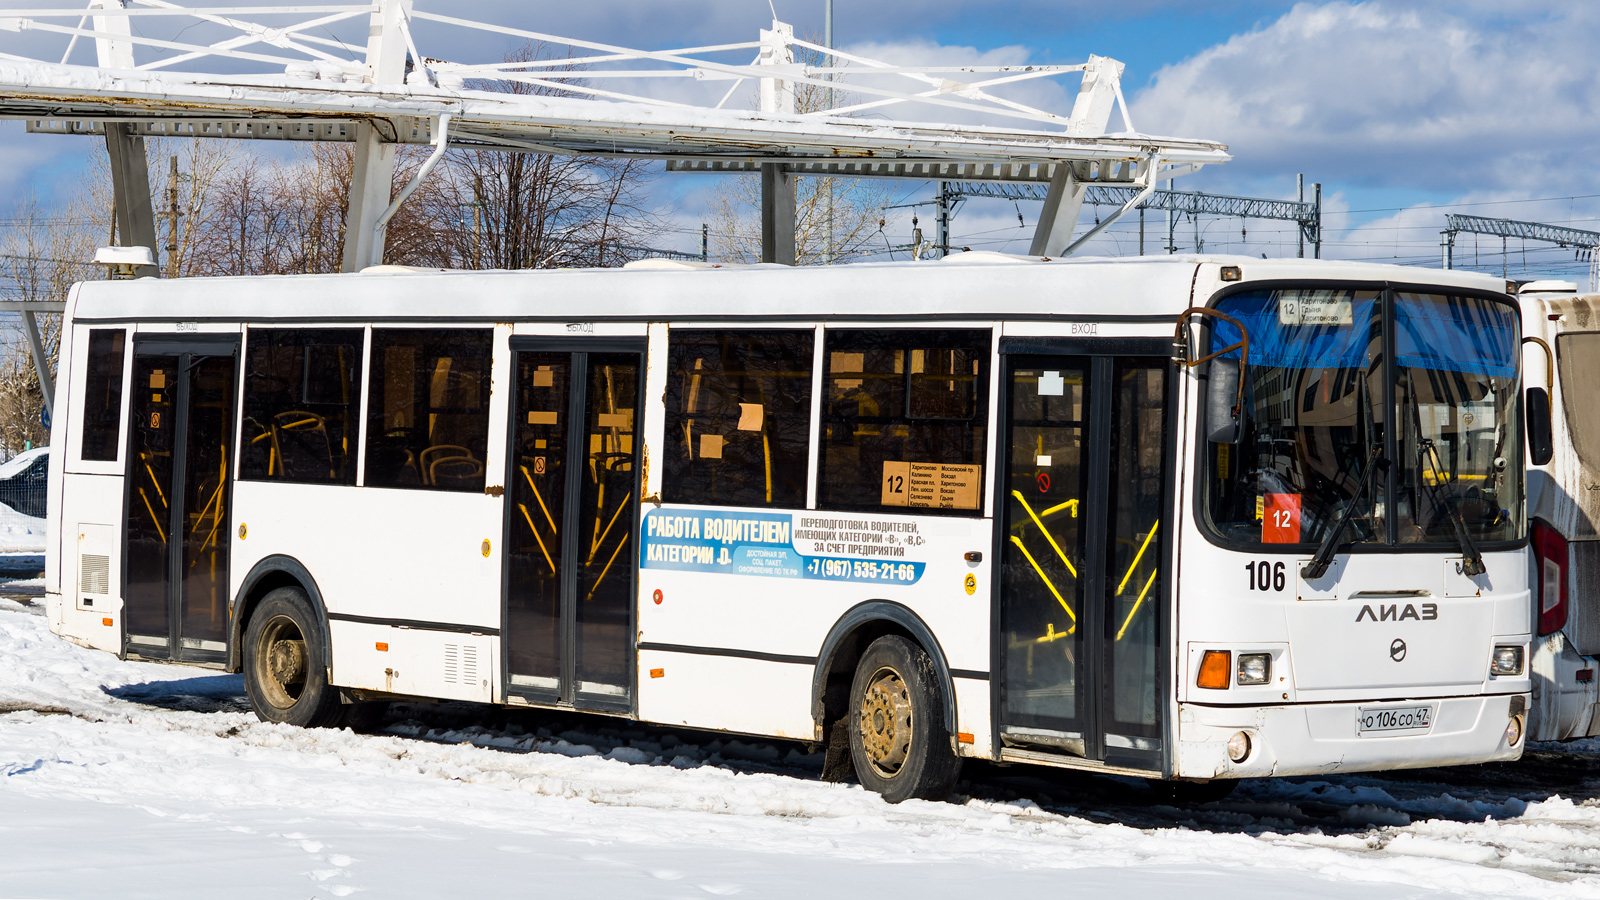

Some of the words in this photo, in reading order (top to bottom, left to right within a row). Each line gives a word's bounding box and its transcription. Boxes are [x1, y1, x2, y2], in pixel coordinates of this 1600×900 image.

[1283, 303, 1295, 315] 12
[1071, 323, 1097, 335] ВХОД
[887, 475, 904, 493] 12
[800, 517, 869, 531] ПЕРЕПОДГОТОВКА
[870, 521, 919, 535] ВОДИТЕЛЕЙ,
[1273, 509, 1291, 528] 12
[647, 515, 700, 539] РАБОТА
[703, 517, 790, 545] ВОДИТЕЛЕМ
[794, 529, 837, 542] ИМЕЮЩИХ
[838, 531, 883, 544] КАТЕГОРИИ
[646, 543, 714, 565] КАТЕГОРИИ
[746, 549, 777, 558] ДОСТОЙНАЯ
[814, 542, 825, 552] ЗА
[826, 542, 846, 554] СЧЕТ
[848, 544, 905, 557] ПРЕДПРИЯТИЯ
[808, 559, 820, 575] +7
[821, 559, 852, 579] (967)
[853, 561, 915, 581] 535-21-66
[1245, 561, 1286, 591] 106
[1355, 603, 1438, 622] ЛИАЗ
